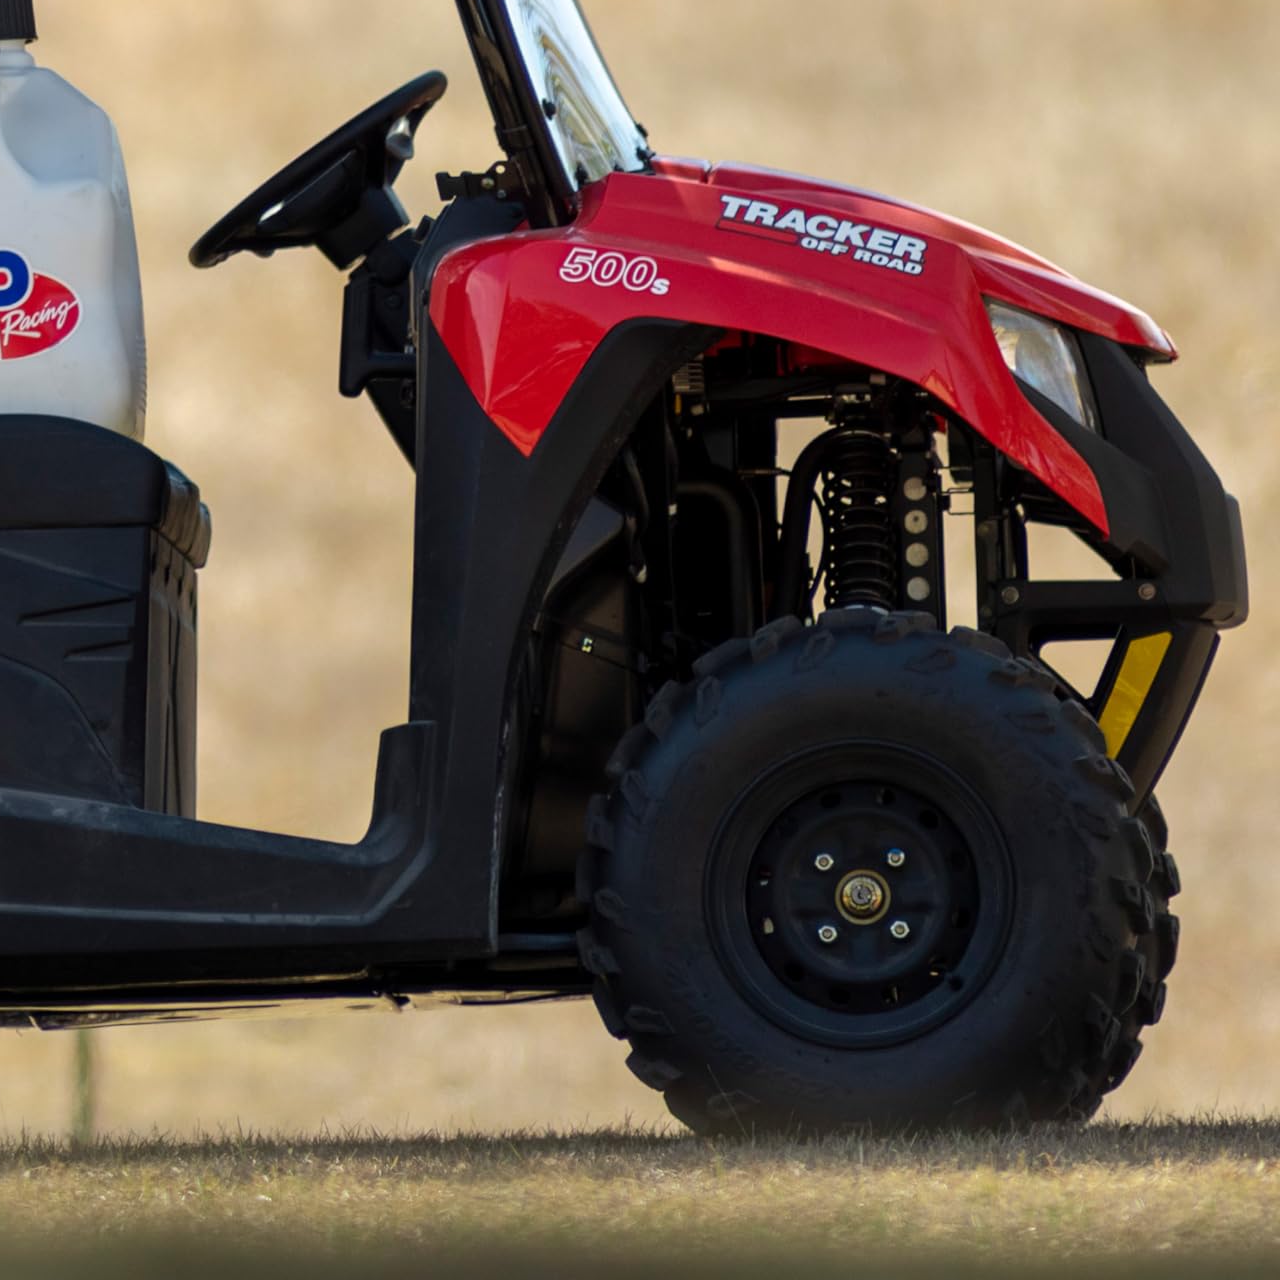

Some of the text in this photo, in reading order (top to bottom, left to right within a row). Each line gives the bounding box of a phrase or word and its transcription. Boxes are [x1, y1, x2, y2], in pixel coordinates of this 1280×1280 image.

[720, 195, 927, 261] TRACKER
[801, 237, 923, 275] OFF ROAD
[0, 300, 80, 346] Racing
